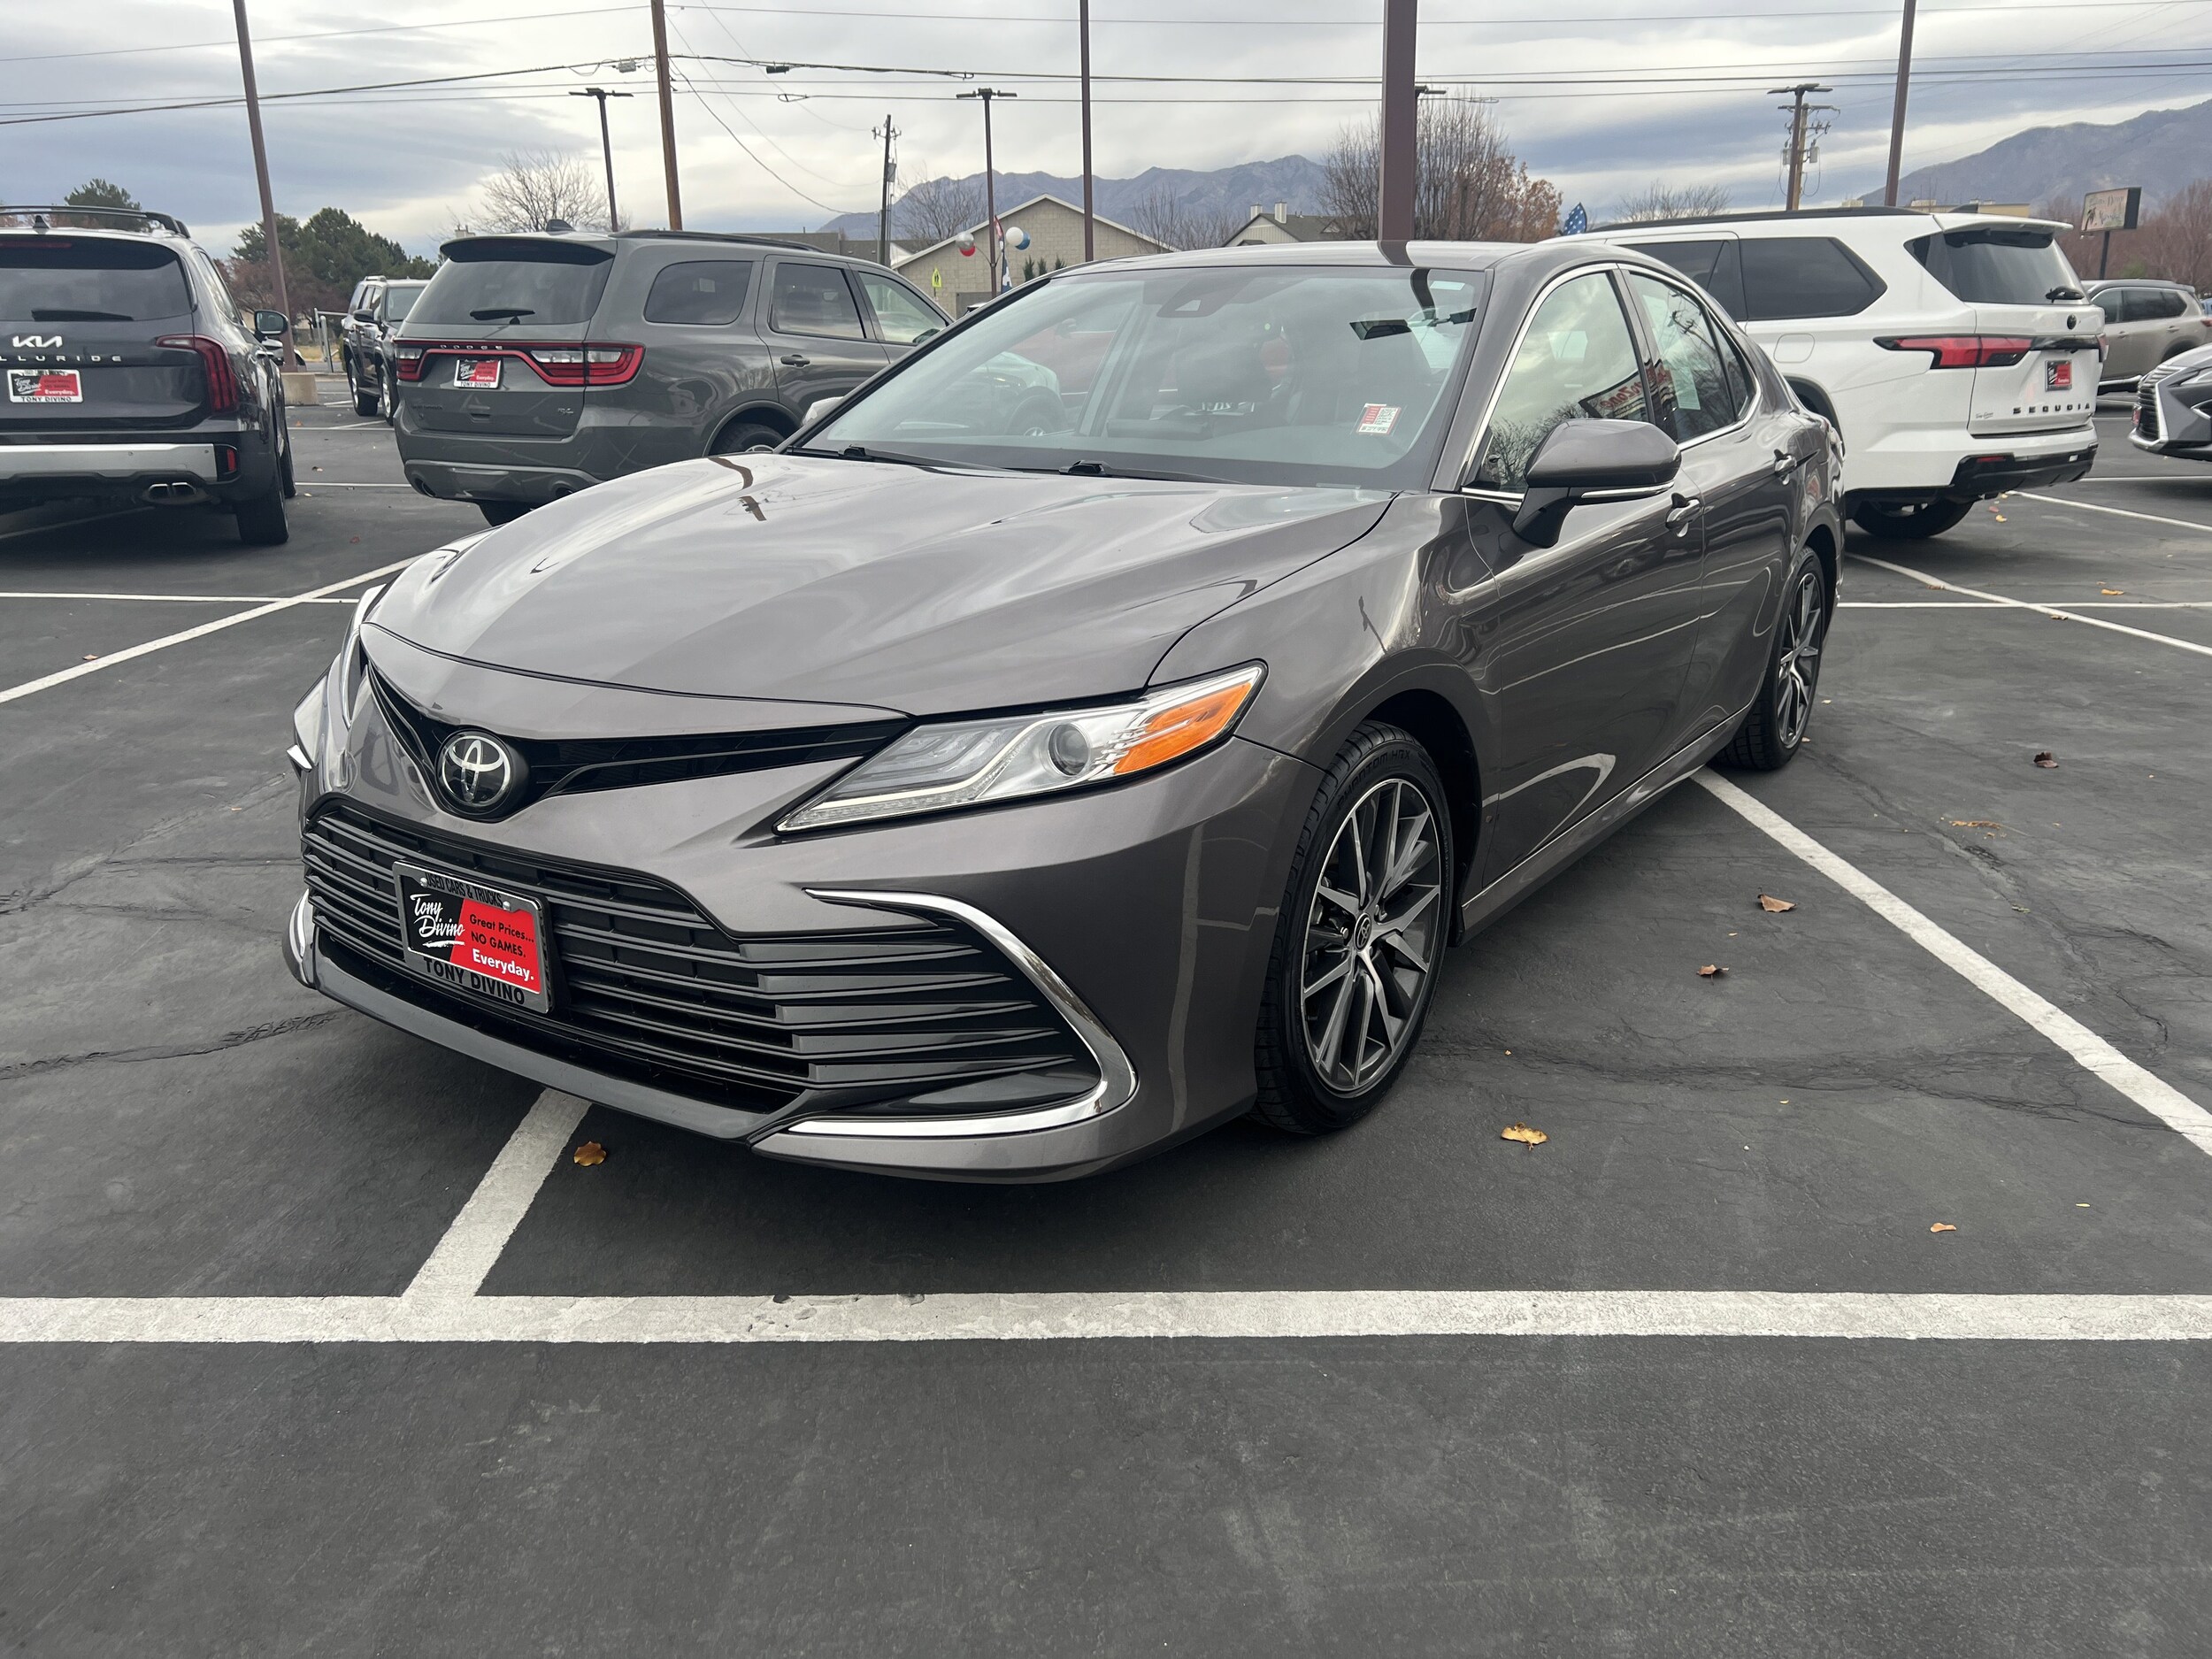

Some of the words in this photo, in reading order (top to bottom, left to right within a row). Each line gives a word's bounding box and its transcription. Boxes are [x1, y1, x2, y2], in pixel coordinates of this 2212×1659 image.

[12, 335, 63, 348] KIA
[2013, 403, 2091, 414] SEQUOIA
[425, 872, 445, 890] USED
[446, 878, 465, 897] CARS
[466, 886, 474, 900] &
[473, 887, 503, 908] TRUCKS
[410, 894, 443, 922] Tony
[413, 915, 465, 938] Divino
[470, 914, 496, 931] Great
[498, 922, 534, 942] Prices...
[471, 931, 488, 945] NO
[489, 937, 526, 958] GAMES.
[472, 948, 534, 981] Everyday.
[424, 956, 465, 985] TONY
[471, 972, 526, 1005] DIVINO
